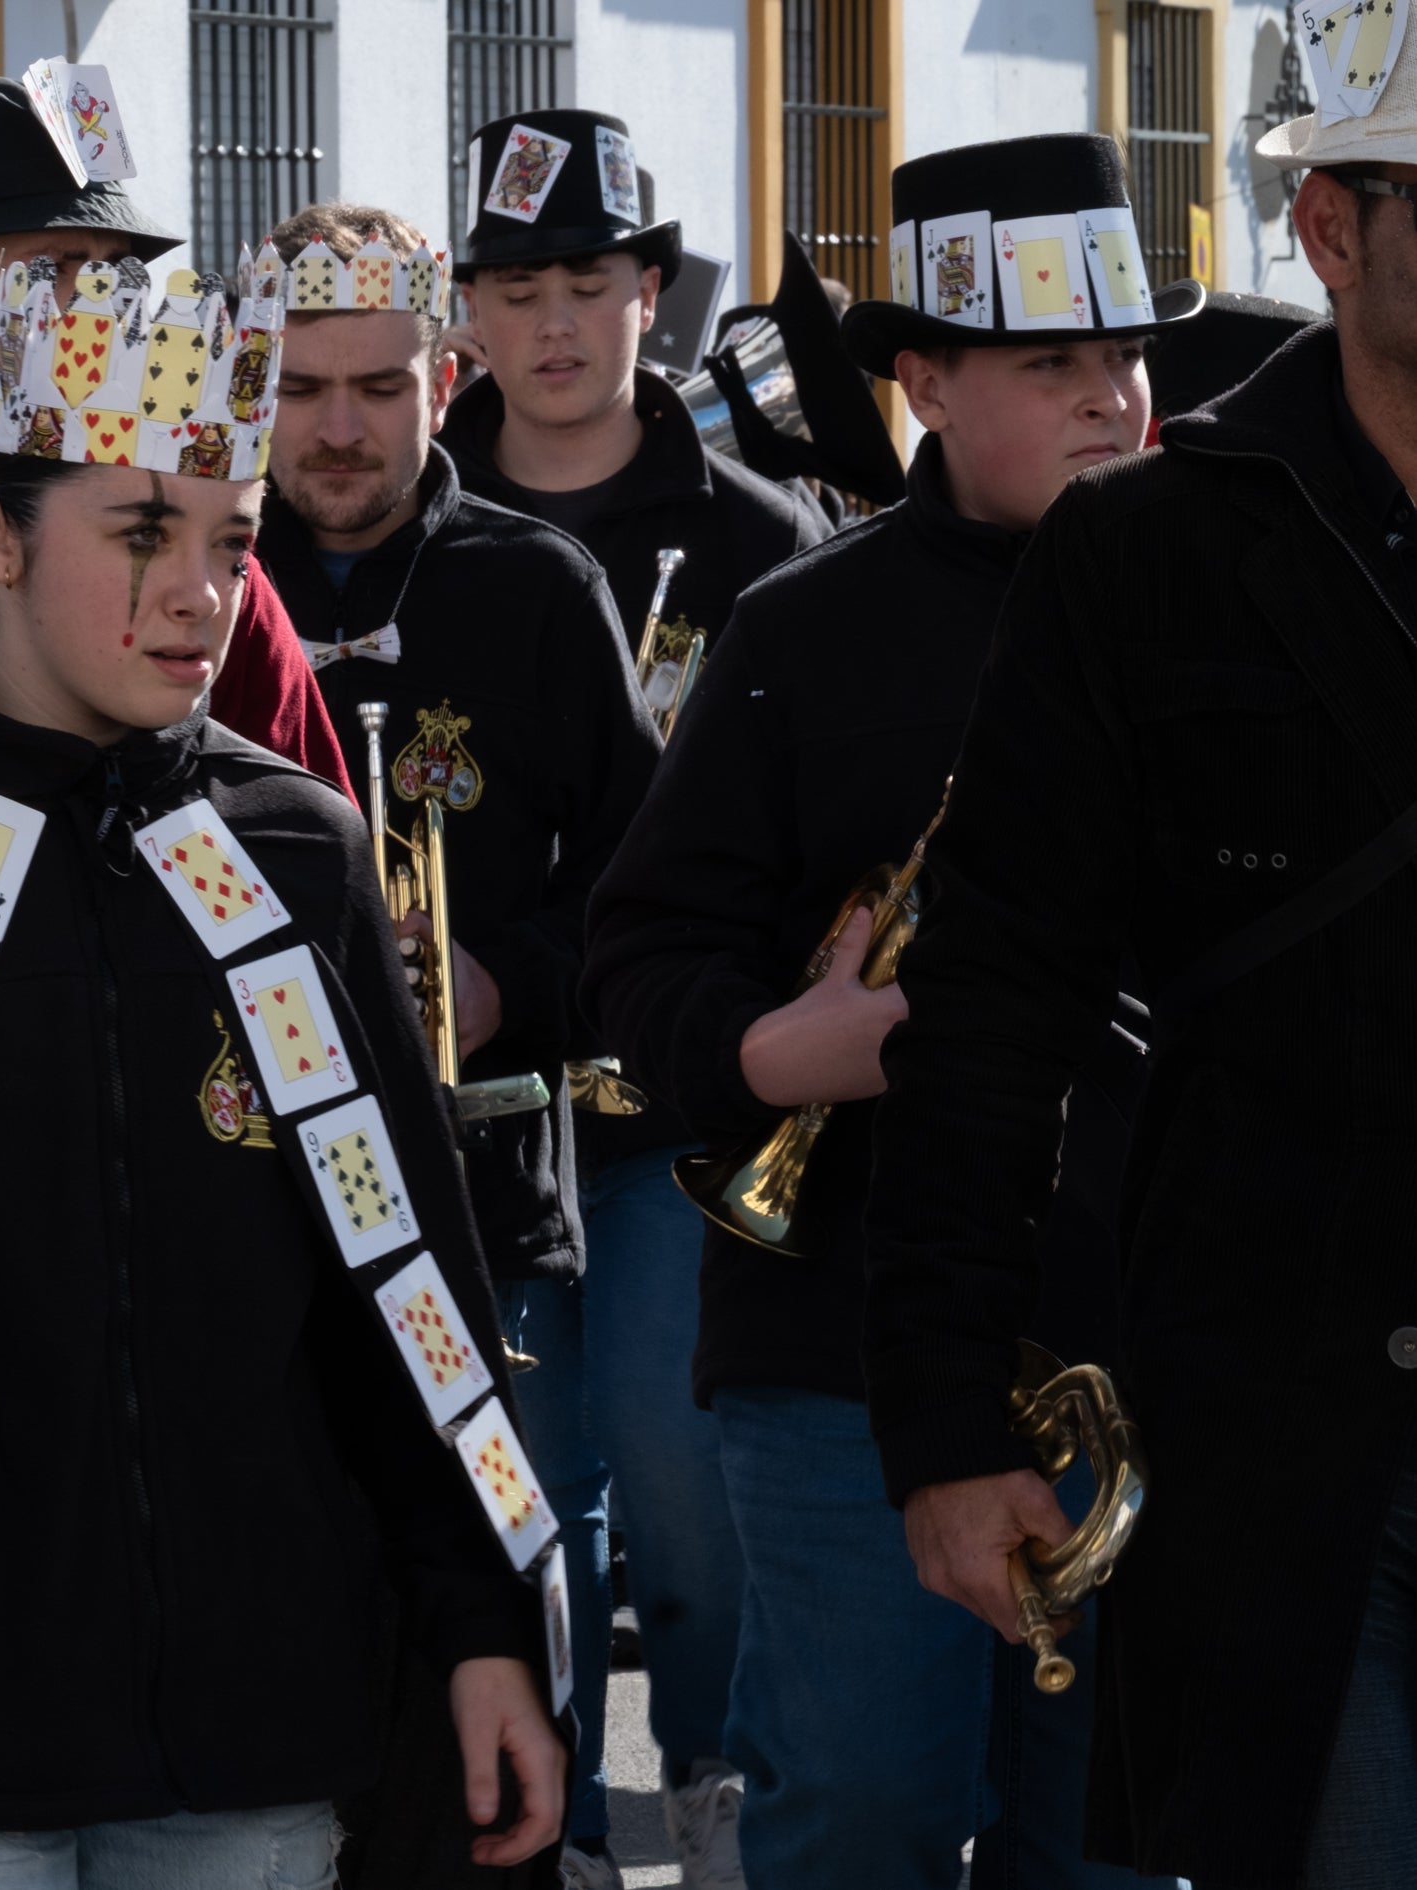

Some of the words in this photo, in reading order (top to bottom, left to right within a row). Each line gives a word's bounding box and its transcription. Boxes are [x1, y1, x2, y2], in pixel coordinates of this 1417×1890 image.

[1301, 9, 1315, 30] 5
[927, 229, 934, 246] J
[1001, 229, 1015, 247] A
[1085, 220, 1095, 237] A
[977, 306, 986, 323] J
[1072, 308, 1086, 325] A
[144, 836, 159, 857] 7
[265, 898, 281, 918] 7
[236, 978, 251, 1000] 3
[333, 1061, 347, 1083] 3
[307, 1131, 320, 1153] 9
